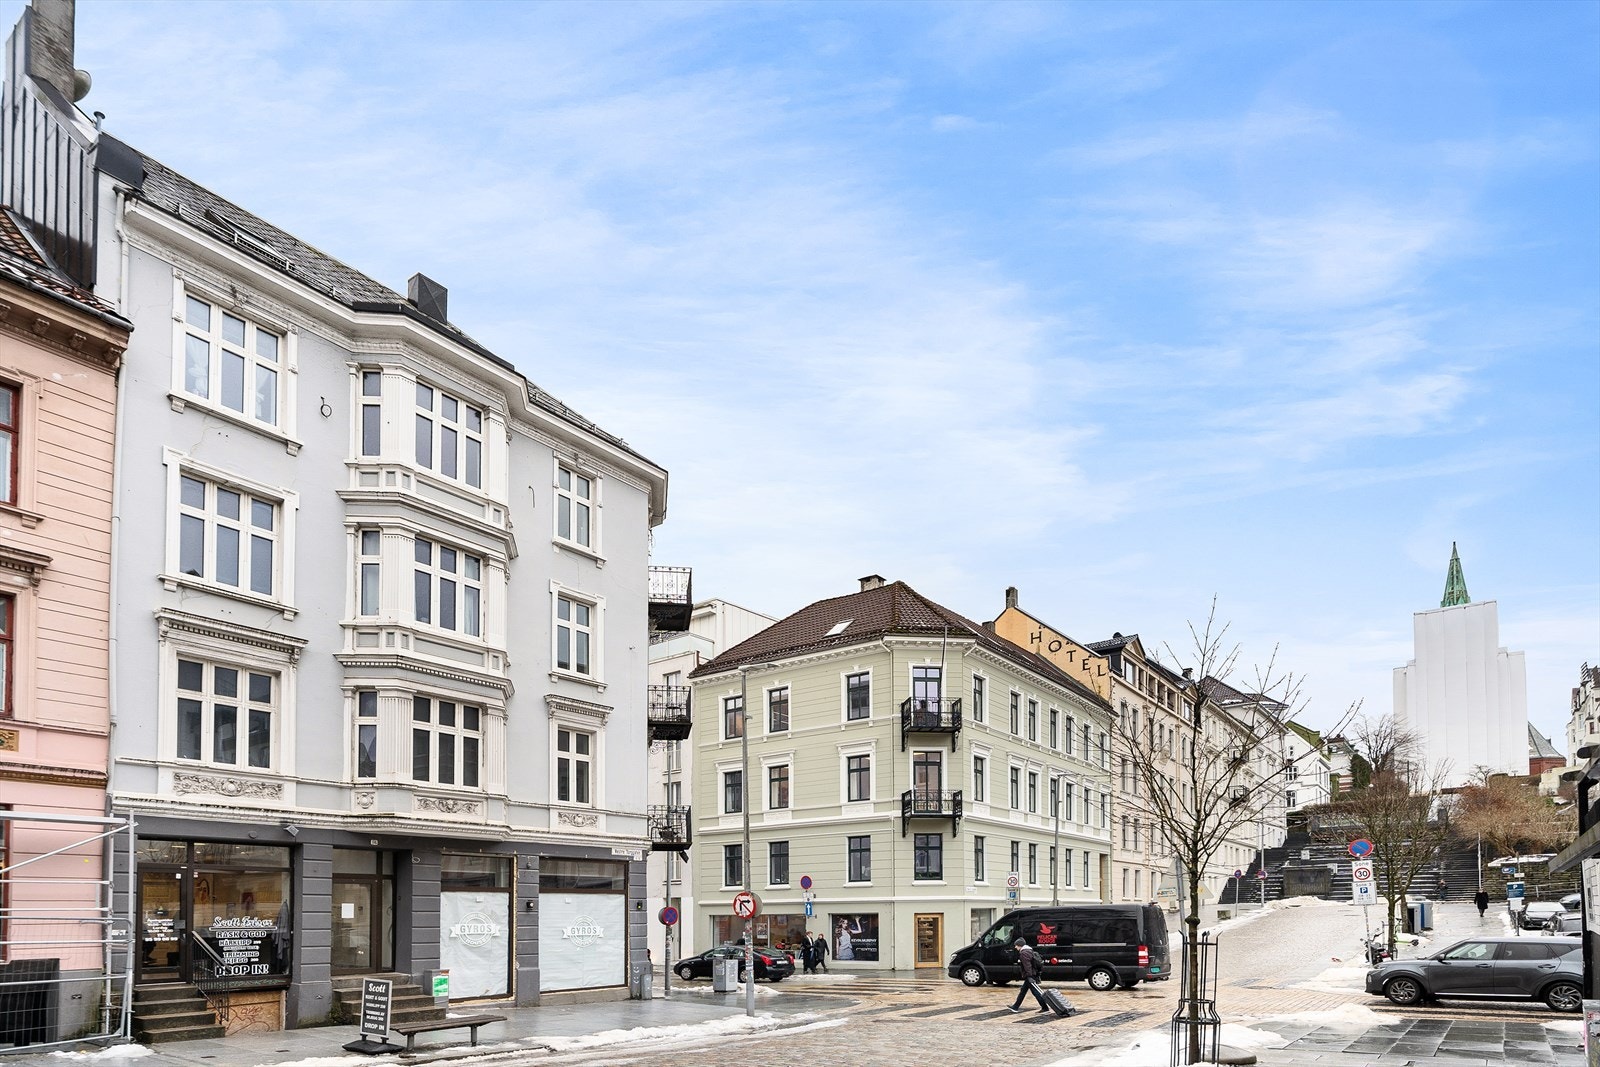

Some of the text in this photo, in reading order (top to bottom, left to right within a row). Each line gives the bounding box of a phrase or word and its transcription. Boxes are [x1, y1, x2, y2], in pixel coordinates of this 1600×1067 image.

[1030, 631, 1106, 677] HOTEL
[1358, 870, 1368, 878] 30
[213, 915, 241, 927] Scott
[460, 924, 492, 934] GYROS
[570, 926, 597, 935] GYROS
[216, 930, 267, 939] RASK & GOD
[251, 964, 269, 975] IN!
[368, 982, 386, 993] Scott
